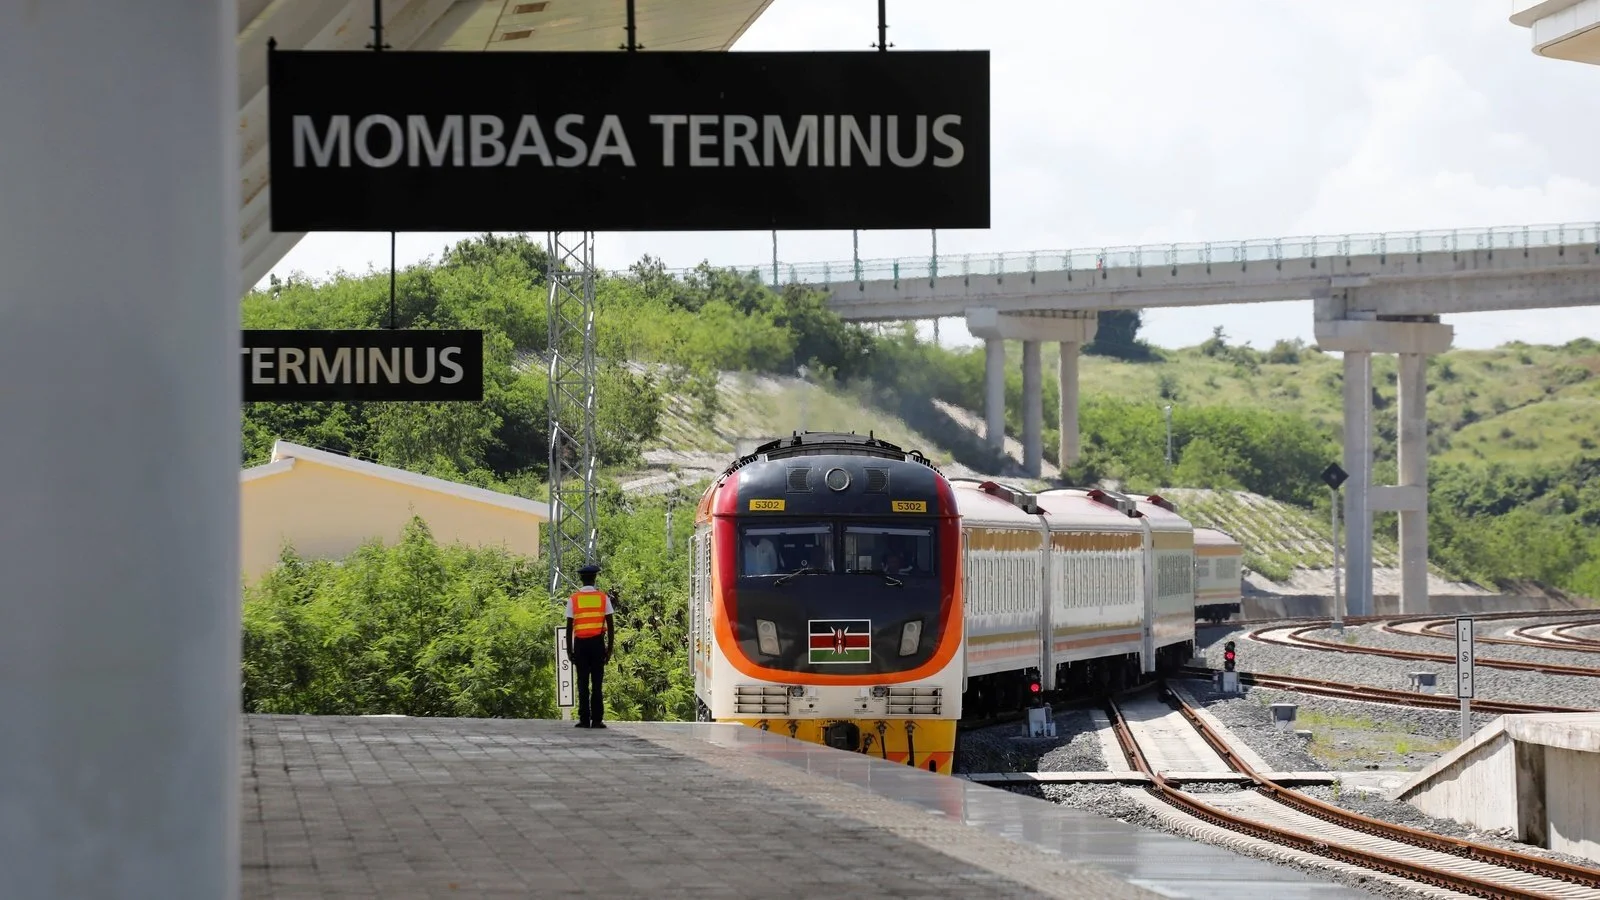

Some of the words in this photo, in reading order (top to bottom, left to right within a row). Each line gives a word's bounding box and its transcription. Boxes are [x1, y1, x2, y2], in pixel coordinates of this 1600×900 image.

[292, 114, 637, 168] MOMBASA
[649, 114, 965, 168] TERMINUS
[755, 501, 779, 509] 5302
[897, 502, 921, 511] 5302
